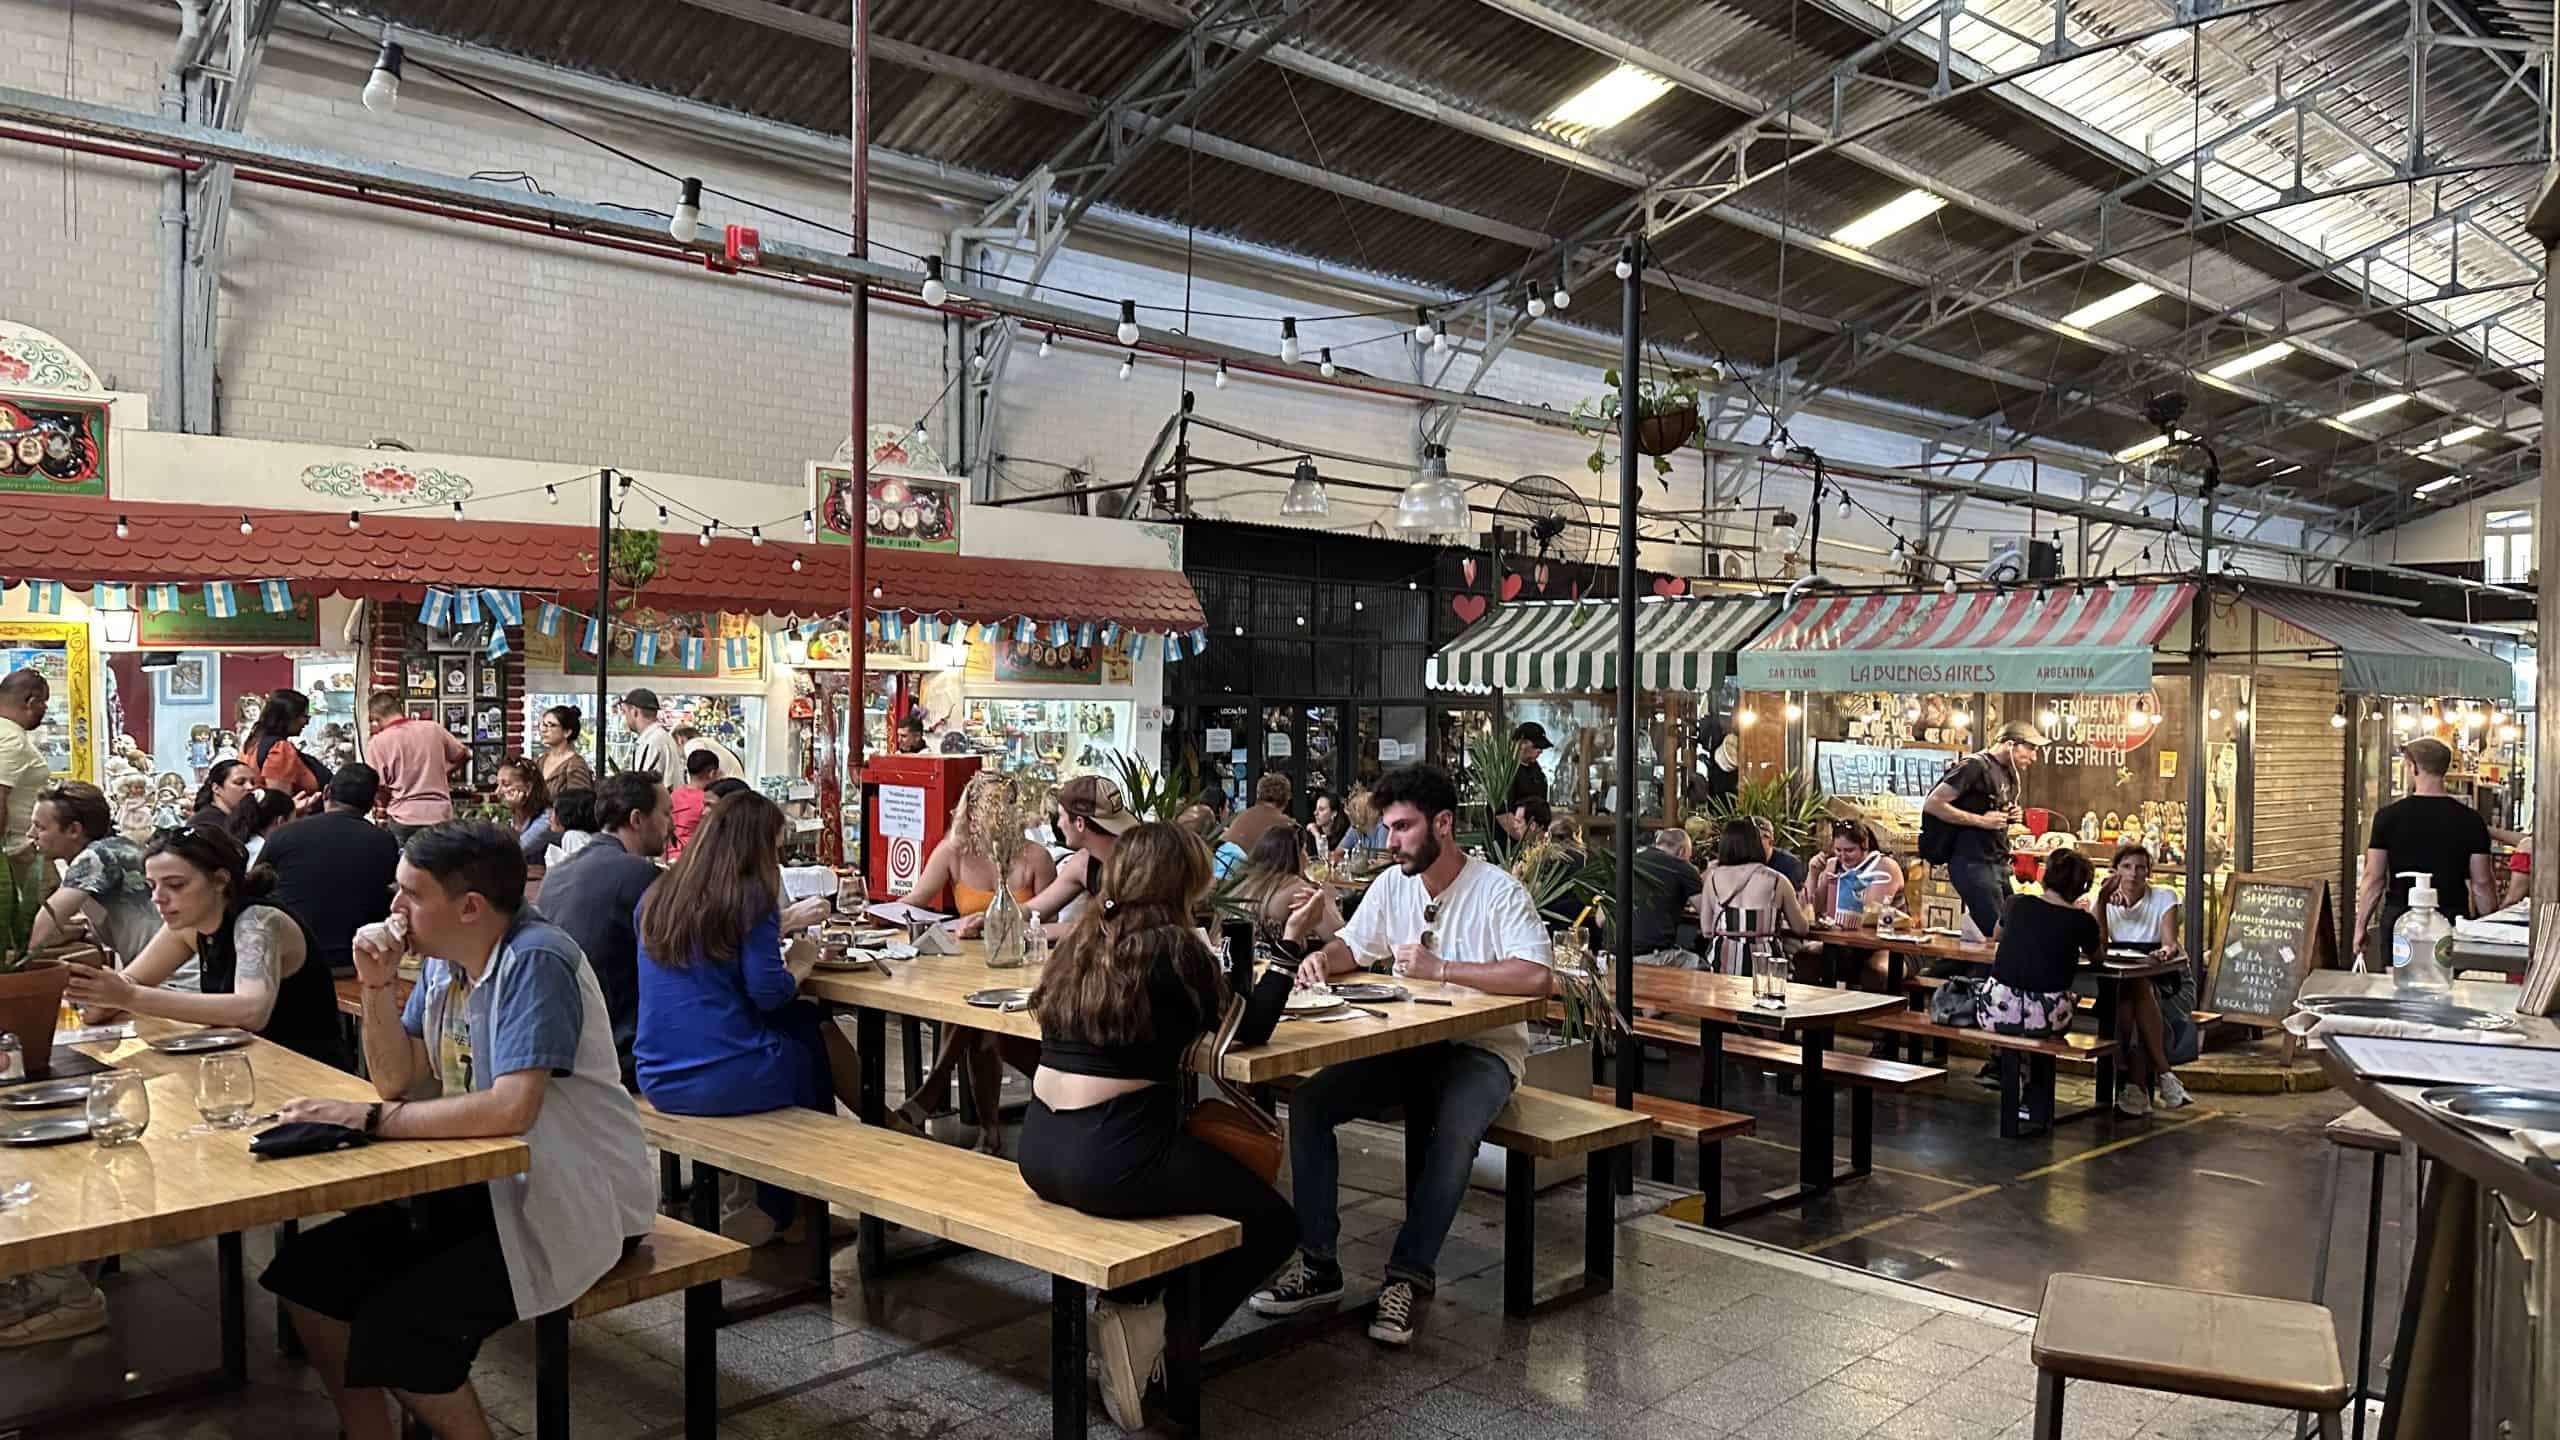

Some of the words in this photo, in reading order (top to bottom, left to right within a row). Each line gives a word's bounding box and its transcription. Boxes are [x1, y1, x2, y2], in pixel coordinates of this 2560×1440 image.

[1768, 667, 1785, 679] SAN
[1788, 667, 1816, 679] TELMO
[1850, 664, 1870, 682] LA
[1873, 664, 1942, 682] BUENOS
[1945, 664, 1996, 682] AIRES
[2036, 665, 2095, 680] ARGENTINA
[2066, 723, 2127, 744] CUERPO
[2041, 746, 2051, 765] Y
[1872, 775, 1892, 794] BE
[2242, 888, 2305, 909] SHAMPOO
[2260, 906, 2270, 917] Y
